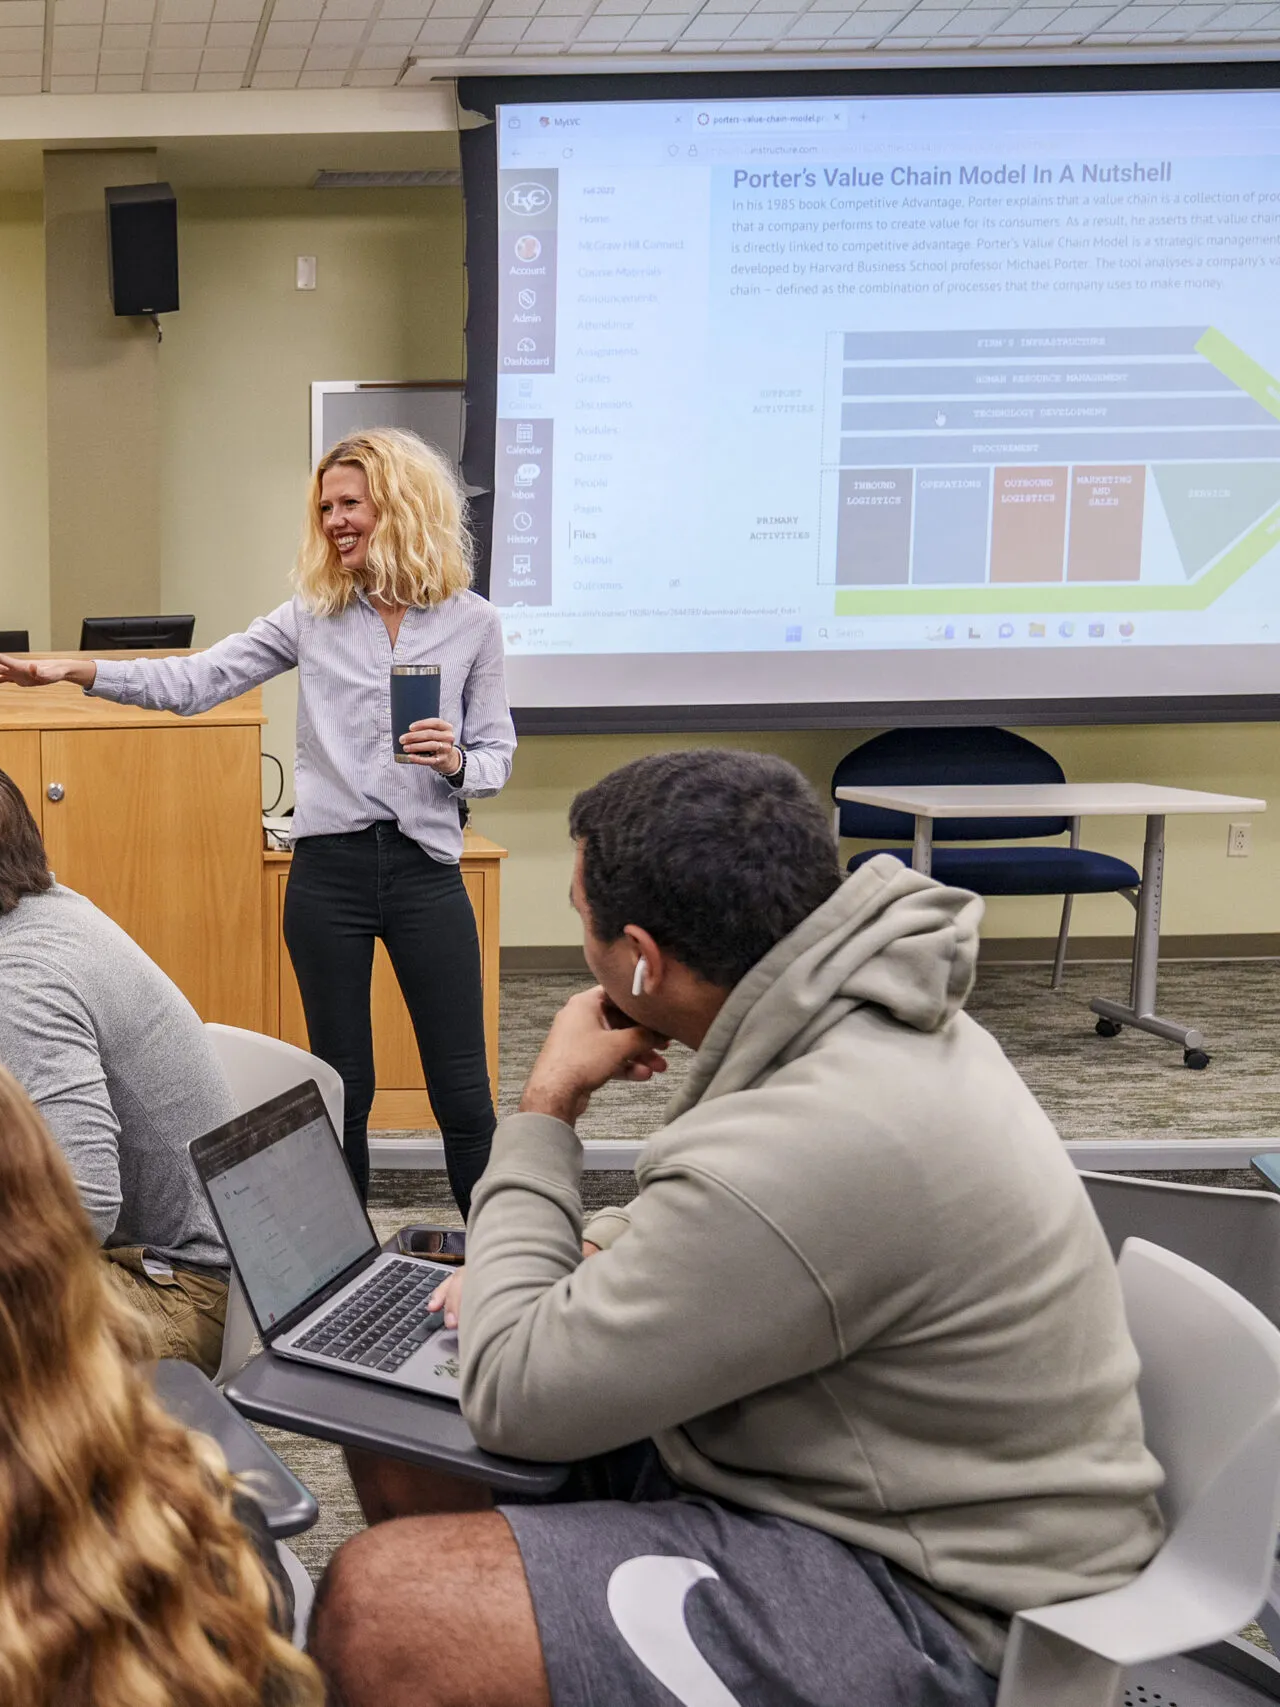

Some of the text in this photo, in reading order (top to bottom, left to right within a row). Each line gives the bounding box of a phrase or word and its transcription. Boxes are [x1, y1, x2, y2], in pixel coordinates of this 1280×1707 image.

[734, 161, 1172, 189] Porter's Value Chain Model In A Nutshell
[733, 200, 743, 210] In
[747, 199, 763, 210] his
[768, 199, 794, 210] 1985
[799, 198, 826, 210] book
[830, 197, 898, 212] Competitive
[968, 196, 1002, 207] Porter
[1006, 195, 1053, 209] explains
[1057, 194, 1080, 206] that
[1083, 197, 1089, 205] a
[1094, 194, 1123, 205] value
[1127, 193, 1157, 204] chain
[1162, 193, 1170, 204] is
[1184, 192, 1240, 204] collection
[1243, 191, 1256, 203] of
[579, 215, 610, 224] Home
[732, 221, 754, 232] that
[758, 224, 764, 232] a
[768, 222, 819, 233] company
[822, 219, 873, 232] performs
[876, 220, 887, 230] to
[891, 218, 926, 230] create
[930, 217, 960, 229] value
[964, 217, 979, 229] for
[982, 217, 995, 228] its
[1066, 216, 1079, 227] As
[1083, 218, 1089, 226] a
[1131, 215, 1145, 226] he
[1149, 214, 1188, 225] asserts
[1191, 214, 1213, 224] that
[1217, 213, 1248, 224] value
[643, 239, 684, 249] Connect
[731, 243, 740, 253] is
[744, 242, 785, 255] directly
[789, 241, 824, 253] linked
[827, 241, 838, 252] to
[842, 240, 909, 254] competitive
[977, 237, 1019, 249] Porter's
[1022, 236, 1054, 248] Value
[1057, 236, 1089, 248] Chain
[1093, 235, 1128, 247] Model
[1132, 235, 1141, 247] is
[1155, 234, 1204, 248] strategic
[731, 262, 789, 275] developed
[793, 262, 806, 275] by
[810, 261, 854, 273] Harvard
[858, 260, 906, 272] Business
[910, 260, 946, 271] School
[951, 259, 1003, 272] professor
[1006, 258, 1050, 270] Michael
[1096, 257, 1116, 268] The
[1119, 256, 1141, 268] tool
[1144, 256, 1194, 270] analyses
[1196, 258, 1203, 267] a
[1206, 255, 1266, 269] company's
[509, 266, 546, 275] Account
[578, 267, 662, 277] Course Materials
[730, 284, 760, 296] chain
[776, 283, 818, 295] defined
[822, 285, 834, 294] as
[838, 283, 856, 294] the
[859, 281, 929, 293] combination
[933, 281, 945, 292] of
[947, 282, 1002, 294] processes
[1006, 280, 1028, 291] that
[1032, 279, 1050, 291] the
[1053, 279, 1104, 293] company
[1107, 280, 1132, 290] uses
[1136, 279, 1147, 289] to
[1151, 277, 1181, 288] make
[578, 294, 658, 304] Announcements
[512, 314, 542, 323] Admin
[577, 321, 636, 330] Attendance
[1021, 337, 1106, 347] INFRASTRUCTURE
[576, 347, 639, 358] Assignments
[504, 357, 549, 366] Dashboard
[576, 374, 611, 384] Grades
[1066, 373, 1129, 382] MANAGEMENT
[575, 400, 633, 410] Discussions
[752, 404, 814, 414] ACTIVITIES
[1040, 408, 1108, 417] DEVELOPMENT
[575, 425, 620, 436] Modules
[507, 445, 544, 454] Calendar
[972, 444, 1040, 453] PROCUREMENT
[574, 478, 608, 488] People
[920, 479, 982, 490] OPERATIONS
[1004, 479, 1054, 488] OUTBOUND
[1076, 476, 1132, 484] MARKETING
[854, 481, 896, 490] INBOUND
[512, 491, 535, 499] Inbox
[1092, 488, 1110, 496] AND
[847, 496, 903, 505] LOGISTICS
[1001, 494, 1055, 503] LOGISTICS
[1088, 498, 1119, 506] SALES
[756, 516, 799, 525] PRIMARY
[574, 530, 597, 539] Files
[749, 532, 810, 540] ACTIVITIES
[507, 535, 539, 545] History
[573, 555, 613, 566] Syllabus
[508, 578, 536, 587] Studio
